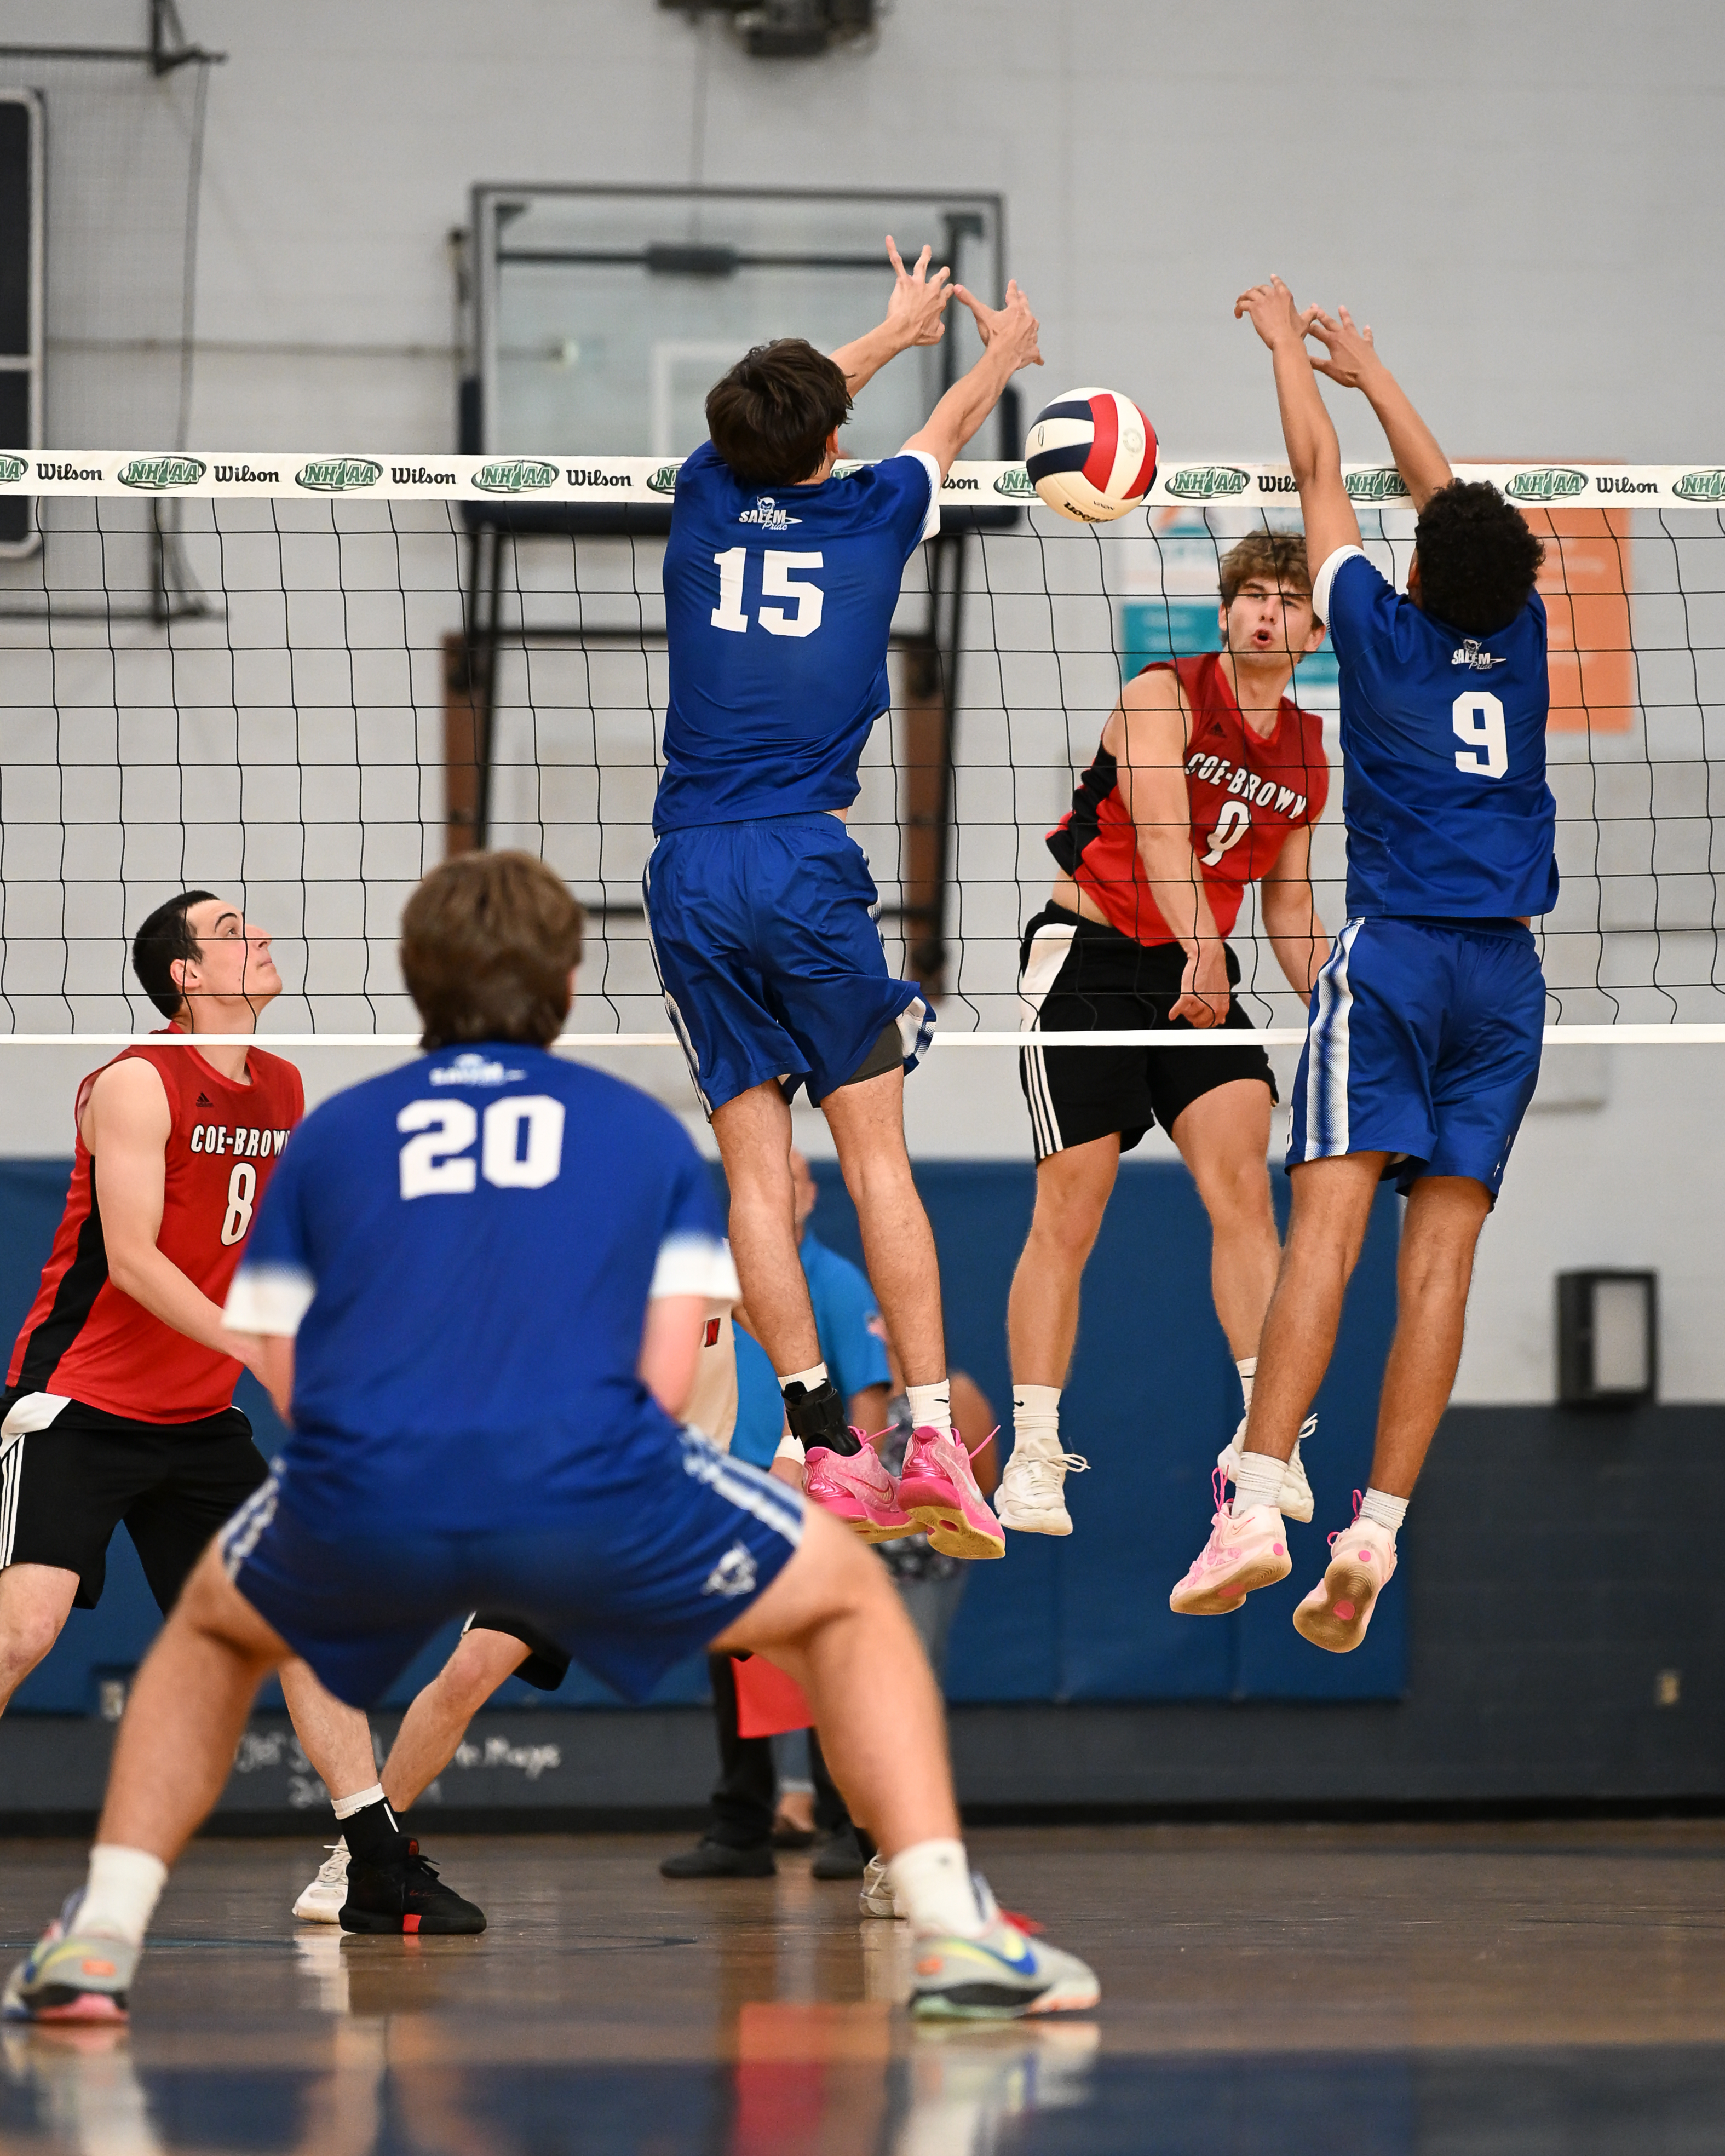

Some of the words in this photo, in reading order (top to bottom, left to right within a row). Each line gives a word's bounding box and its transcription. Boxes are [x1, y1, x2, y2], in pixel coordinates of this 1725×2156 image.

[36, 463, 103, 481] Wilson
[214, 465, 280, 482] Wilson
[391, 467, 457, 485] Wilson
[566, 469, 633, 486] Wilson
[942, 474, 979, 489] lson
[1257, 475, 1298, 492] Wils
[1596, 477, 1658, 493] Wilson
[739, 510, 787, 524] SALEM
[711, 547, 824, 637] 15
[1451, 649, 1491, 665] SALEM
[1452, 691, 1508, 779] 9
[1184, 752, 1307, 820] COE-BROWN
[396, 1094, 566, 1201] 20
[220, 1162, 257, 1246] 8
